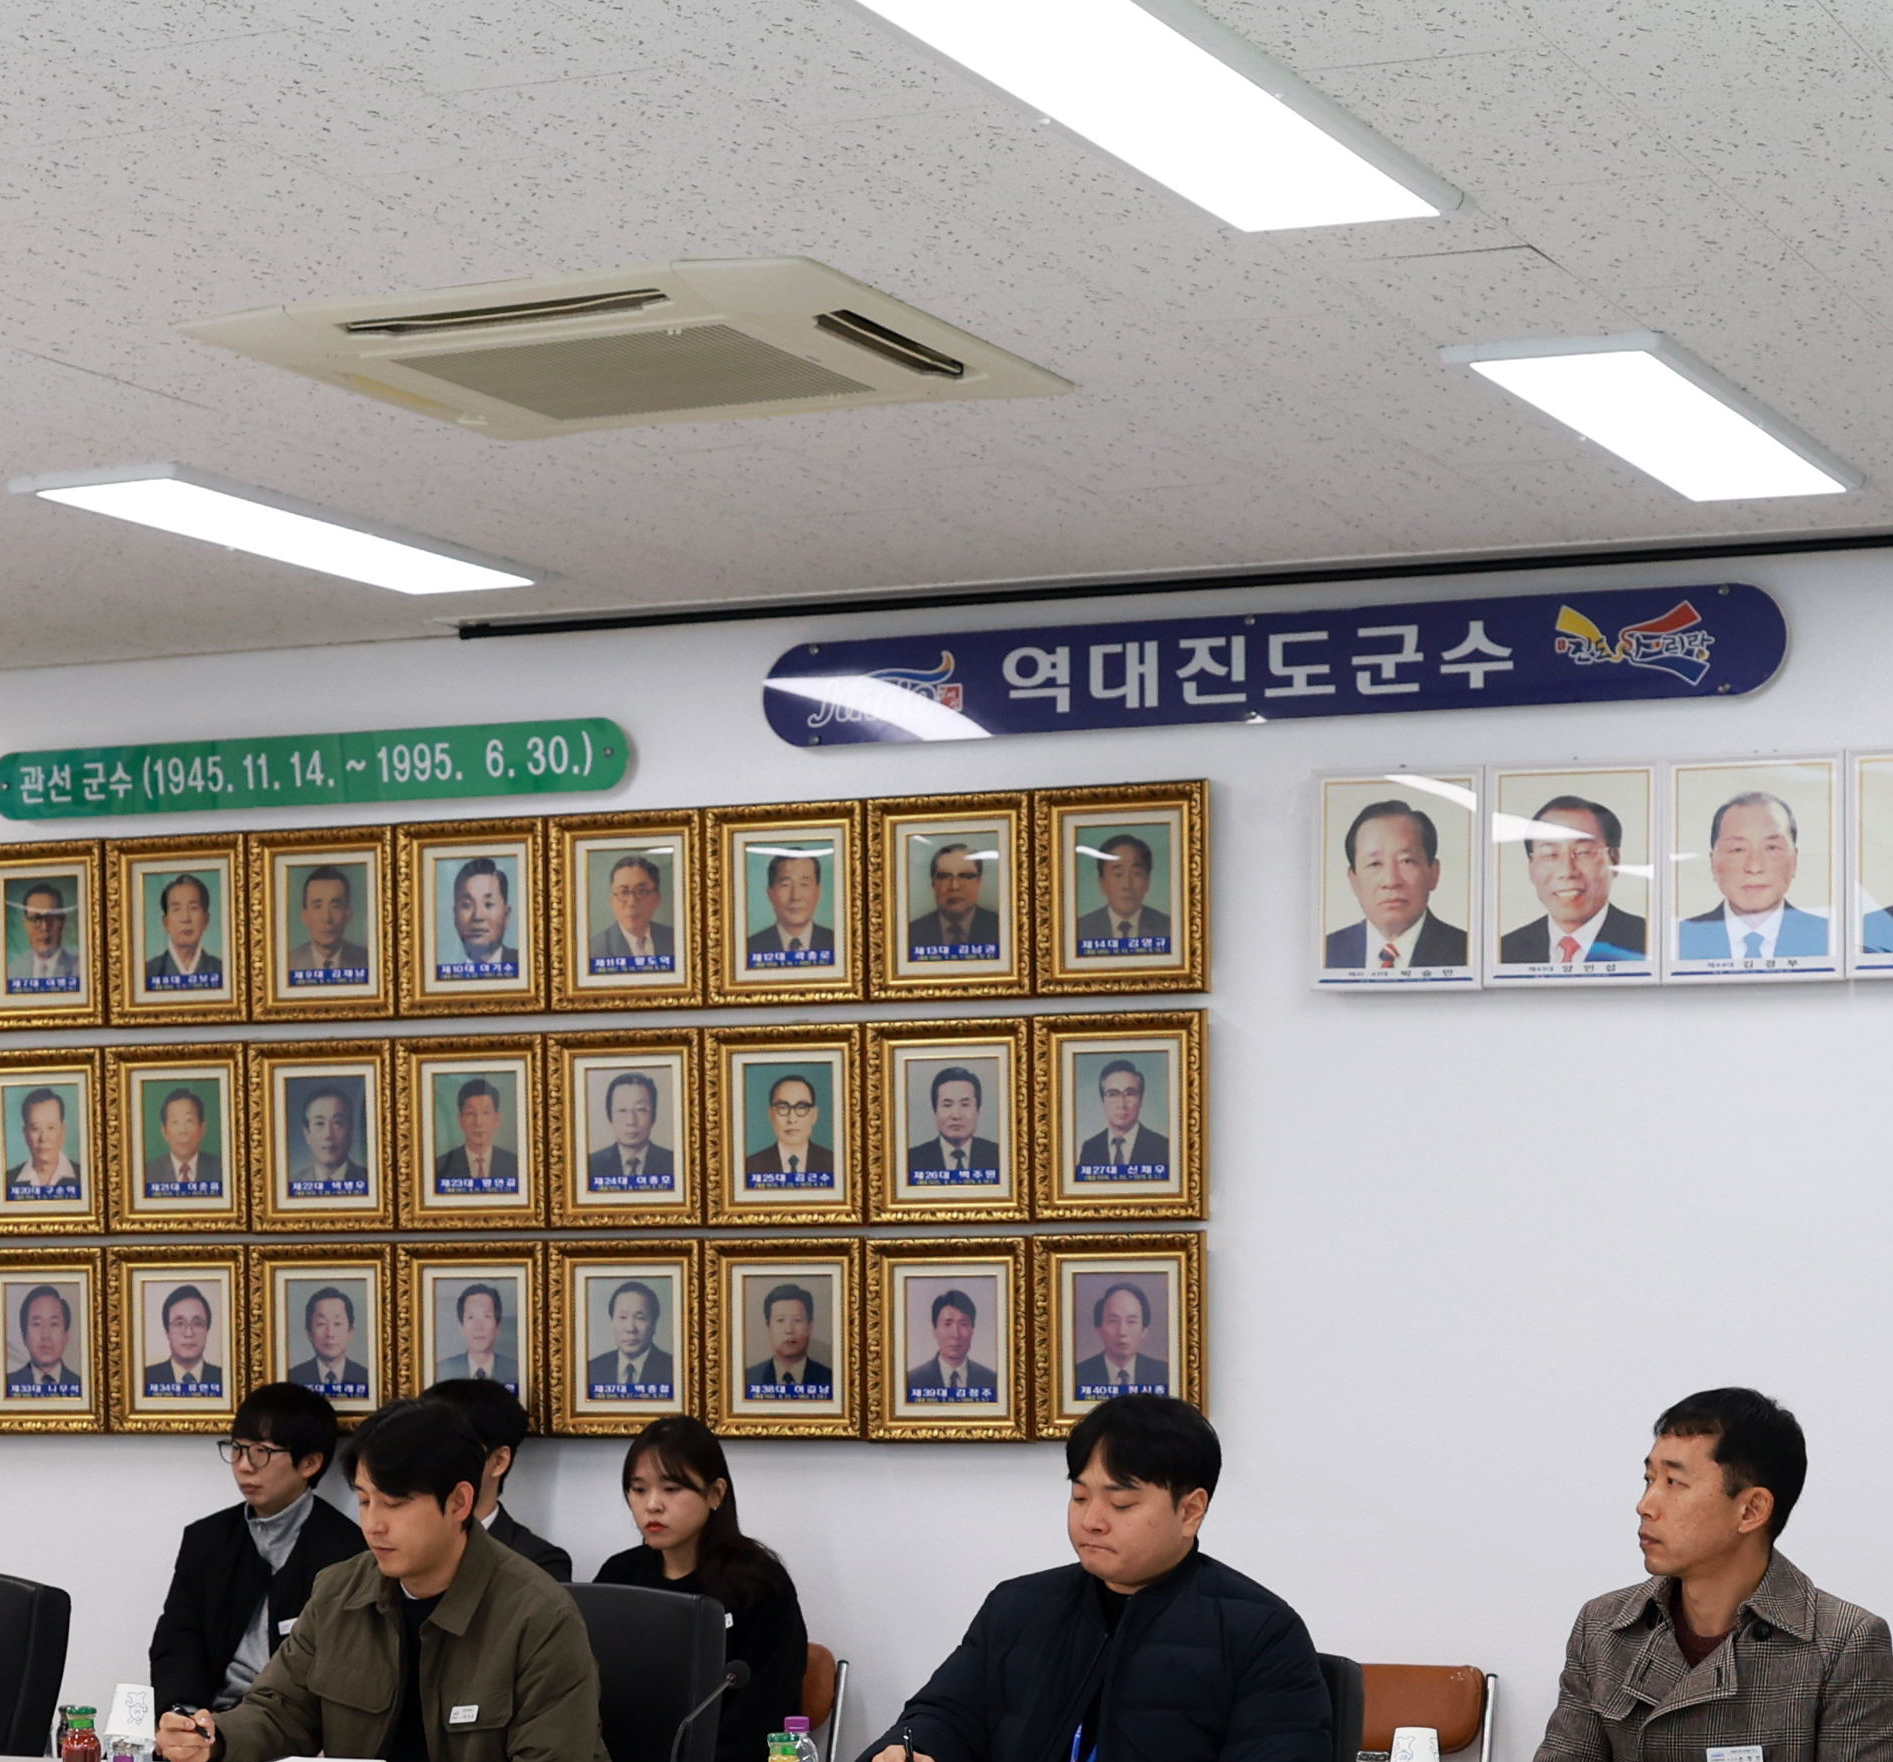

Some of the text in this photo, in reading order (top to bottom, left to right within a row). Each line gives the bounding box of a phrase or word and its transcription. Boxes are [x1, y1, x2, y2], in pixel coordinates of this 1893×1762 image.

[1002, 618, 1515, 715] 역대진도군수
[19, 765, 73, 805] 관선
[82, 761, 133, 801] 군수
[142, 755, 233, 798] (1945.
[242, 754, 280, 792] 11.
[290, 750, 335, 789] 14.
[376, 742, 462, 784] 1995.
[485, 738, 515, 778] 6.
[526, 730, 594, 775] 30.)
